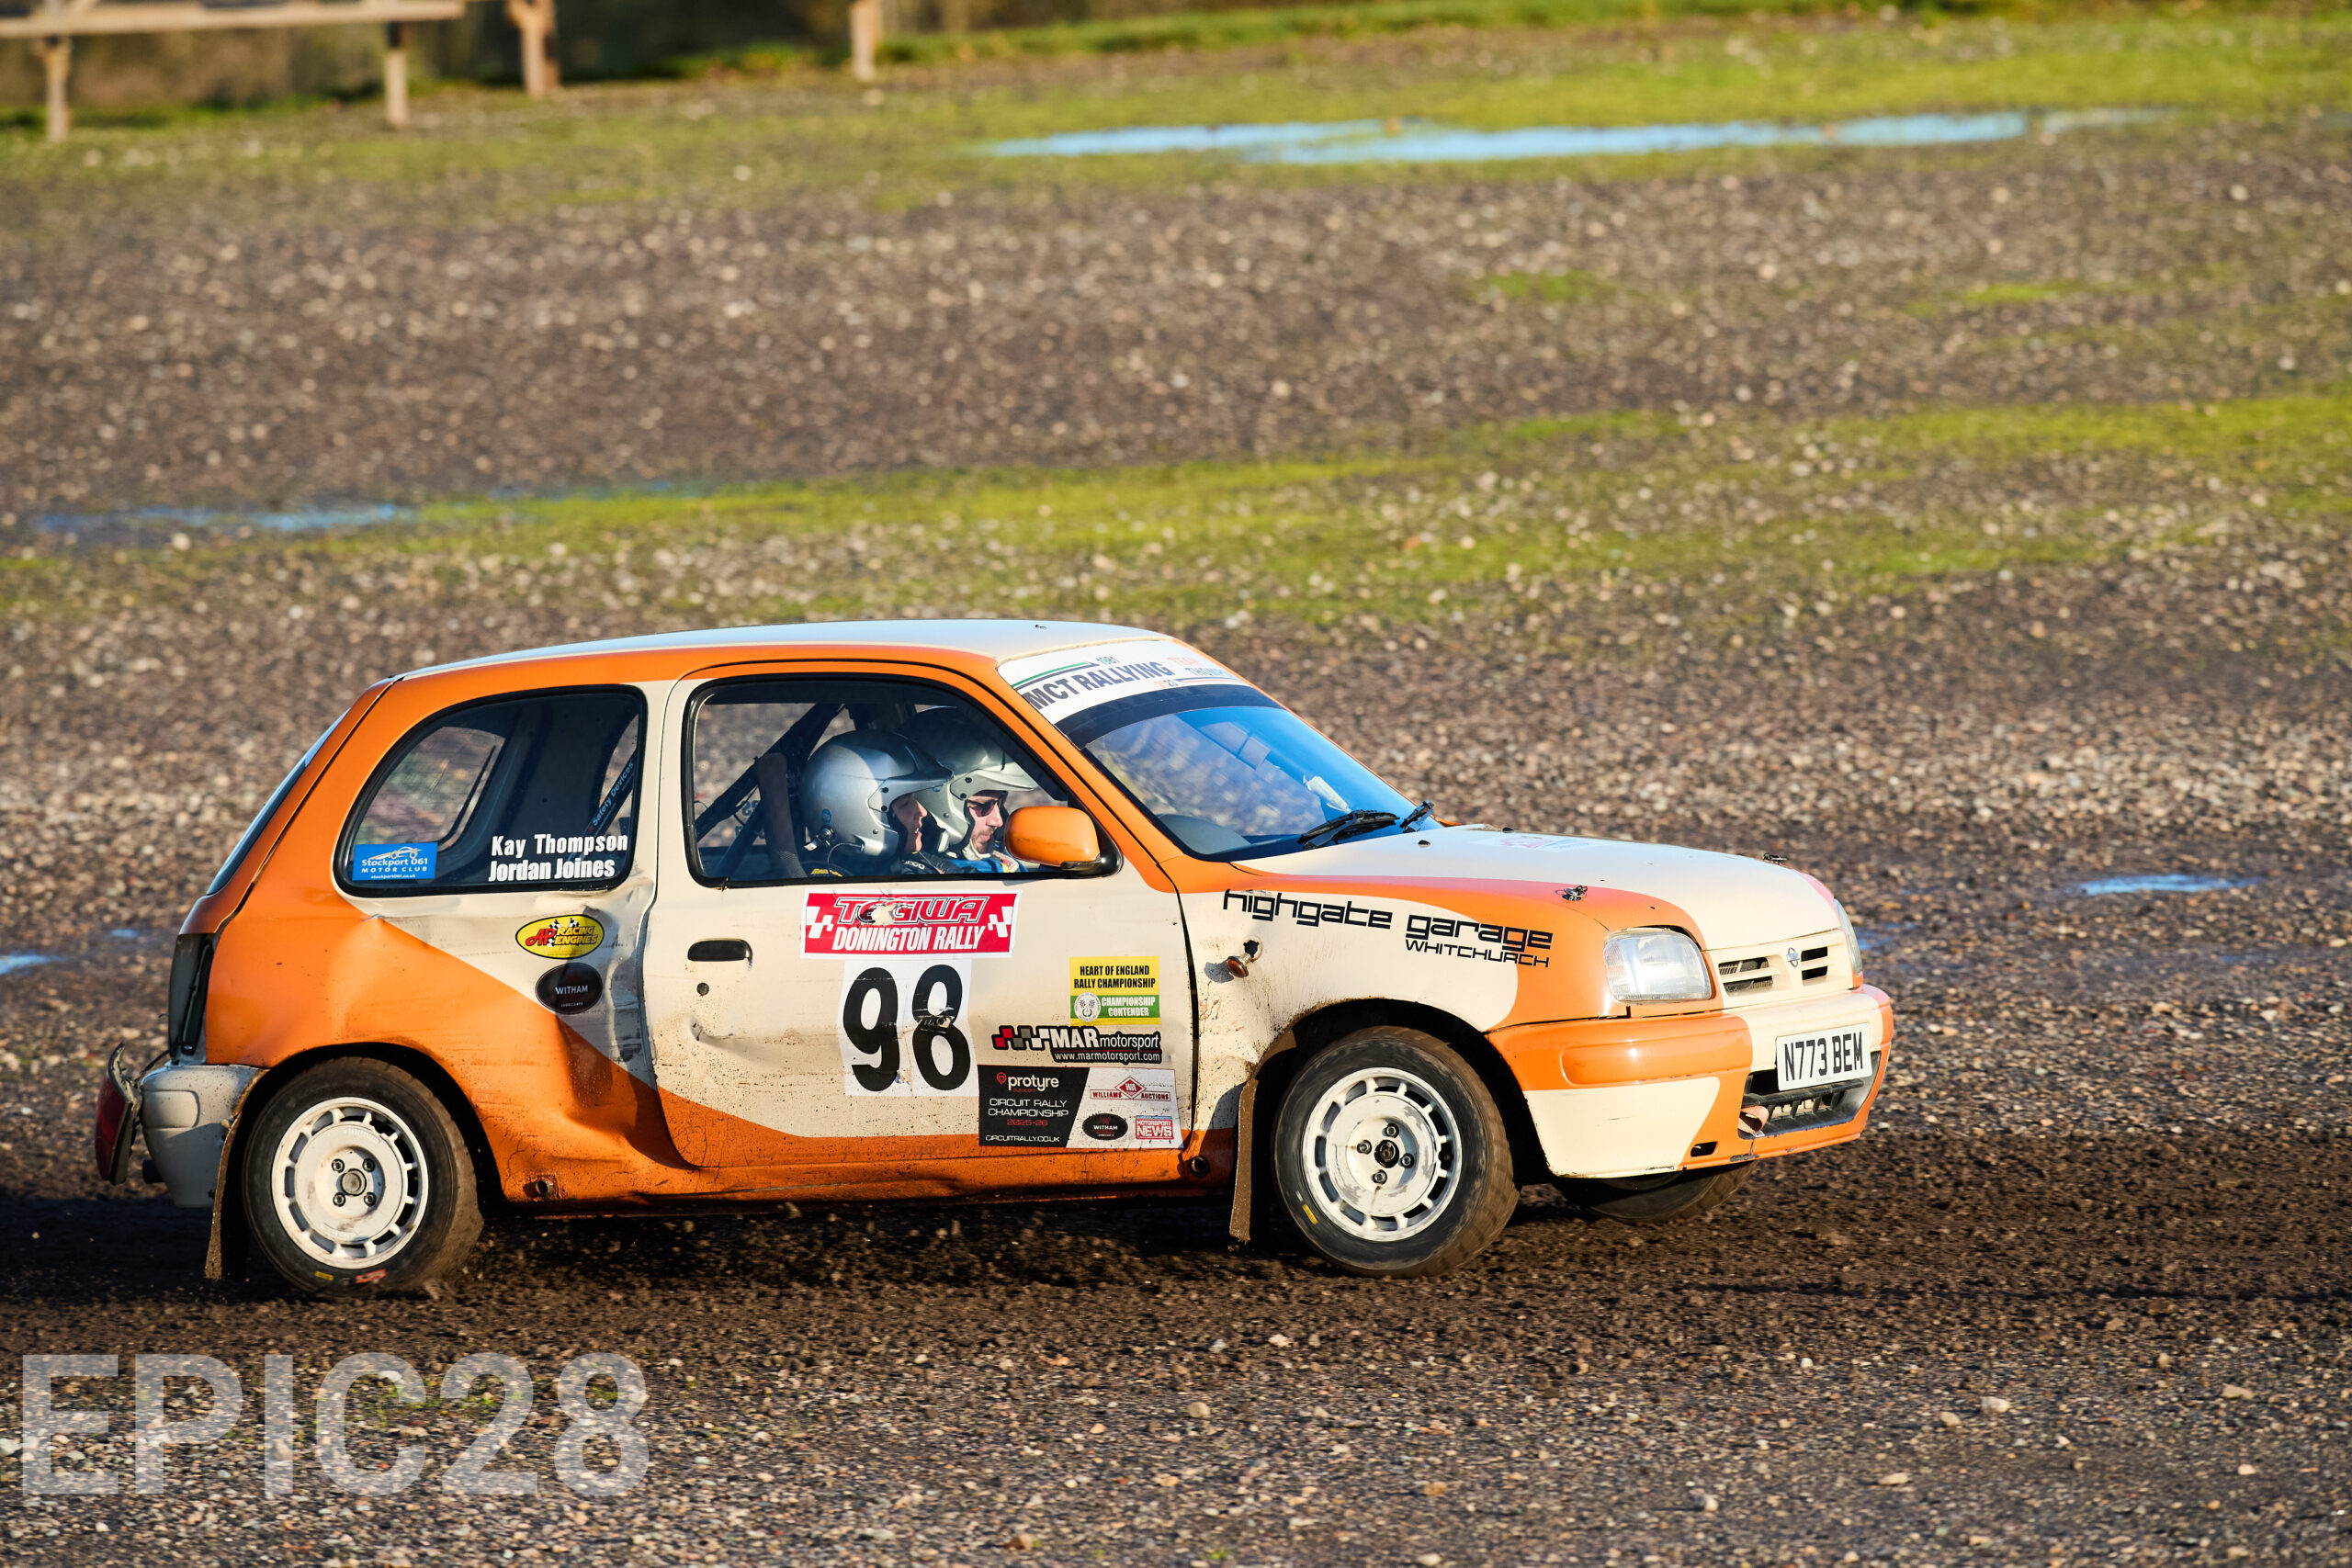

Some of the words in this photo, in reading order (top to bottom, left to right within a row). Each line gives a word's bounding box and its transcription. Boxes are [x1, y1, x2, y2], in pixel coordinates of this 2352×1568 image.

[1022, 678, 1080, 710] MCT
[1071, 661, 1175, 691] RALLYING
[592, 798, 612, 826] Safety
[610, 761, 634, 797] Devices
[492, 836, 526, 858] Kay
[535, 834, 628, 855] Thompson
[361, 859, 410, 867] Stockport
[488, 860, 551, 882] Jordan
[554, 858, 616, 879] Joines
[1223, 889, 1393, 929] highgate
[1406, 914, 1553, 953] garage
[557, 926, 595, 936] RACING
[526, 928, 556, 946] AP
[554, 936, 598, 945] ENGINES
[831, 926, 933, 951] DONINGTON
[933, 925, 987, 950] RALLY
[1406, 939, 1549, 967] WHITCHURCH
[1080, 966, 1103, 976] HEART
[1105, 965, 1114, 976] OF
[1116, 965, 1149, 976] ENGLAND
[1074, 978, 1096, 988] RALLY
[1097, 978, 1156, 988] CHAMPIONSHIP
[555, 985, 588, 995] WITHAM
[1102, 997, 1156, 1006] CHAMPIONSHIP
[1108, 1007, 1149, 1016] CONTENDER
[842, 964, 971, 1092] 98
[1054, 1051, 1160, 1062] www.marmotorsport.com
[1784, 1038, 1828, 1081] N773
[1832, 1032, 1863, 1074] BEM
[1008, 1074, 1059, 1092] protyre
[1125, 1083, 1136, 1091] WA
[989, 1098, 1030, 1106] CIRCUIT
[1034, 1100, 1067, 1108] RALLY
[988, 1108, 1069, 1117] CHAMPIONSHIP
[1007, 1118, 1048, 1126] 2025-26
[1136, 1125, 1172, 1137] NEWS
